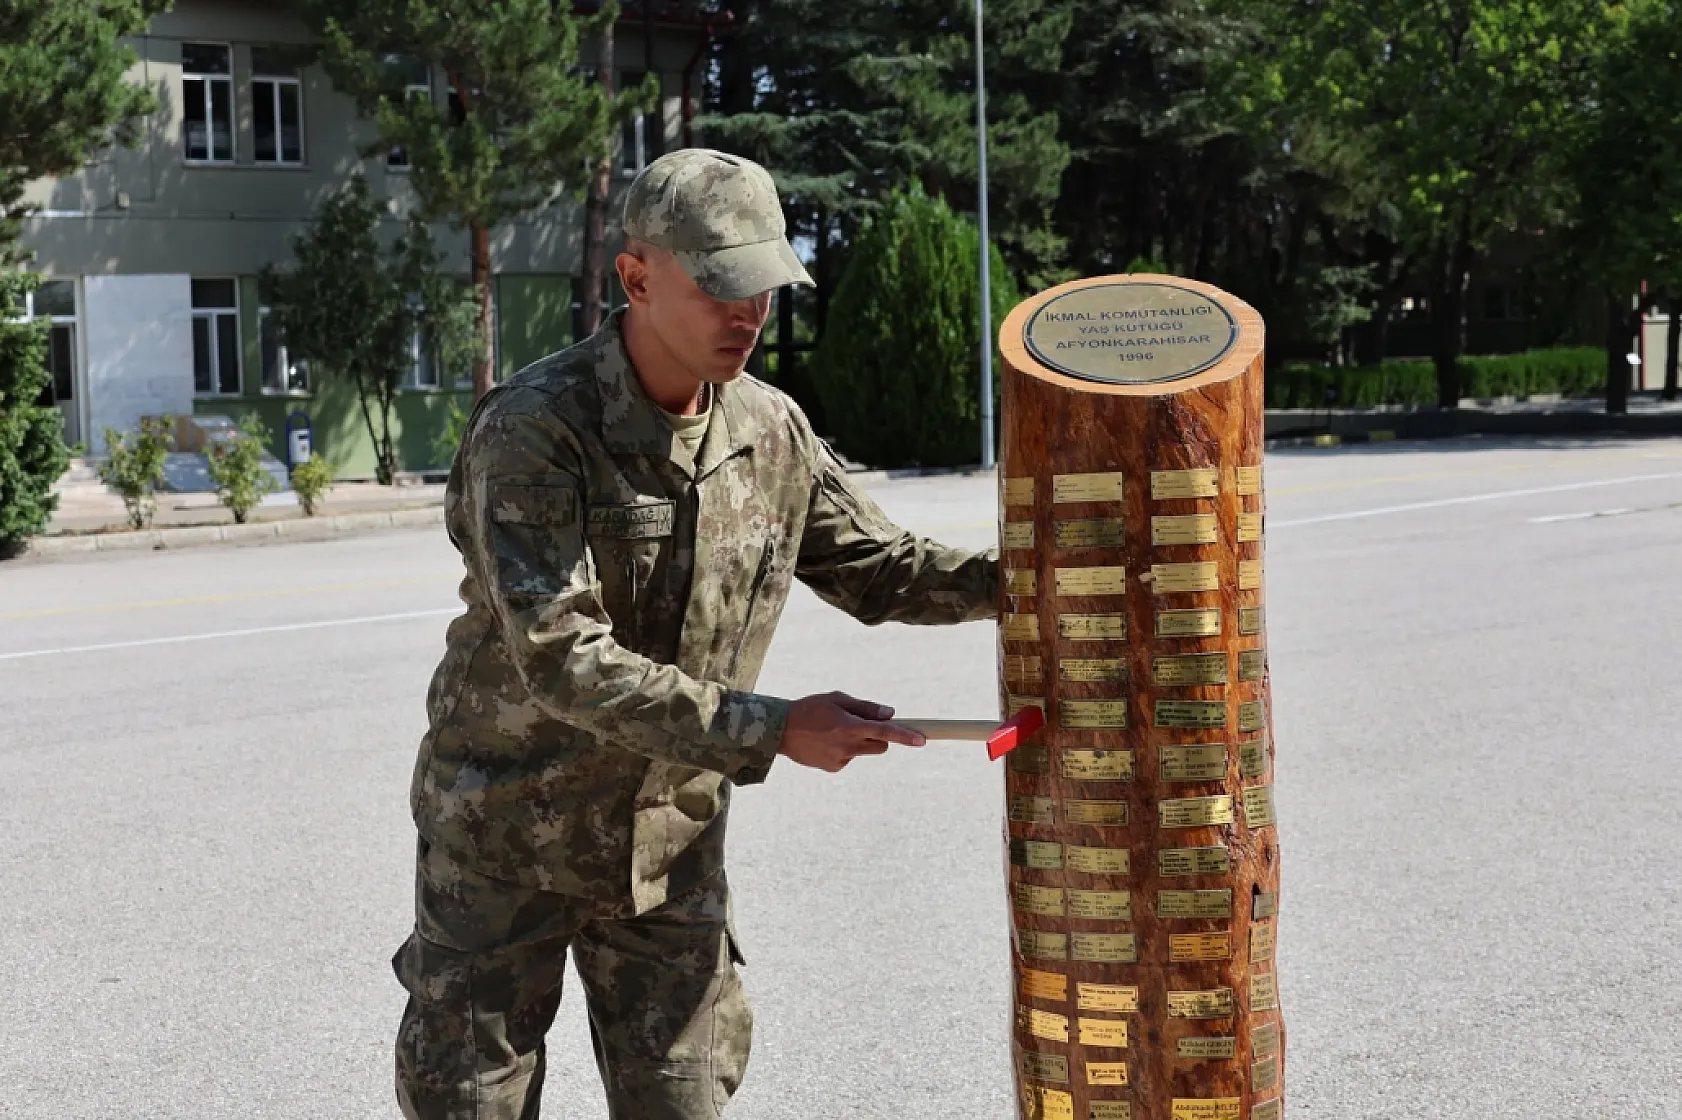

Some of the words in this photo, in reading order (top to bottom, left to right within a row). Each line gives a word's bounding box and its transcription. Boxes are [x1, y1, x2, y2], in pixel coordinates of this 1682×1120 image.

[1046, 310, 1096, 322] İKMAL
[1100, 305, 1213, 320] KOMUTANLIĞI
[1056, 334, 1211, 350] AFYONKARAHİSAR
[1118, 351, 1154, 362] 1996
